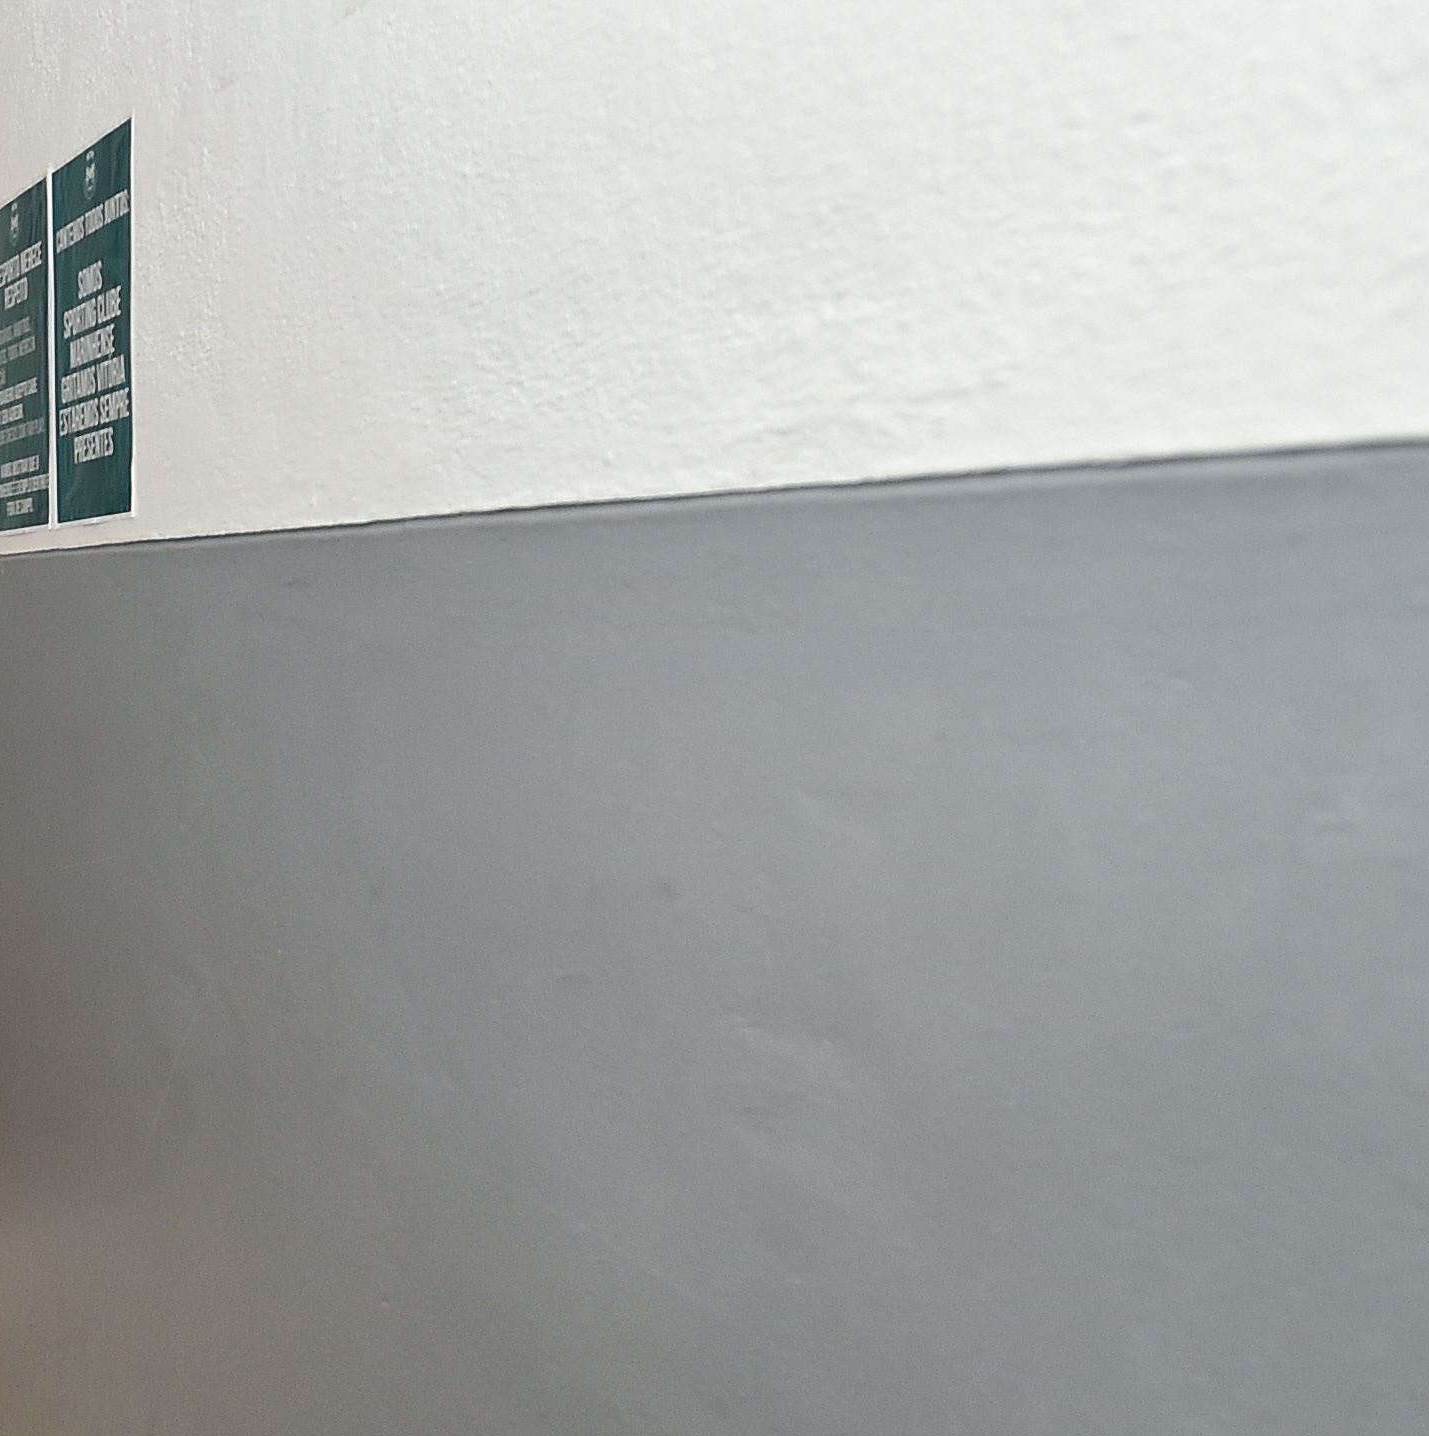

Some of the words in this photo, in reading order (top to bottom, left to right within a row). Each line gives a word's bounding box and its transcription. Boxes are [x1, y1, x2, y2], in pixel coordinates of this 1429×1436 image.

[56, 215, 84, 253] CANTEMOS
[85, 203, 104, 236] TODOS
[78, 260, 103, 299] SOMOS
[63, 298, 97, 339] SPORTING
[97, 285, 122, 323] CLUBE
[69, 323, 115, 369] MARINHENSE
[61, 366, 96, 404] GRITAMOS
[59, 398, 99, 437] ESTAREMOS
[99, 387, 130, 424] SEMPRE
[74, 427, 114, 465] PRESENTES
